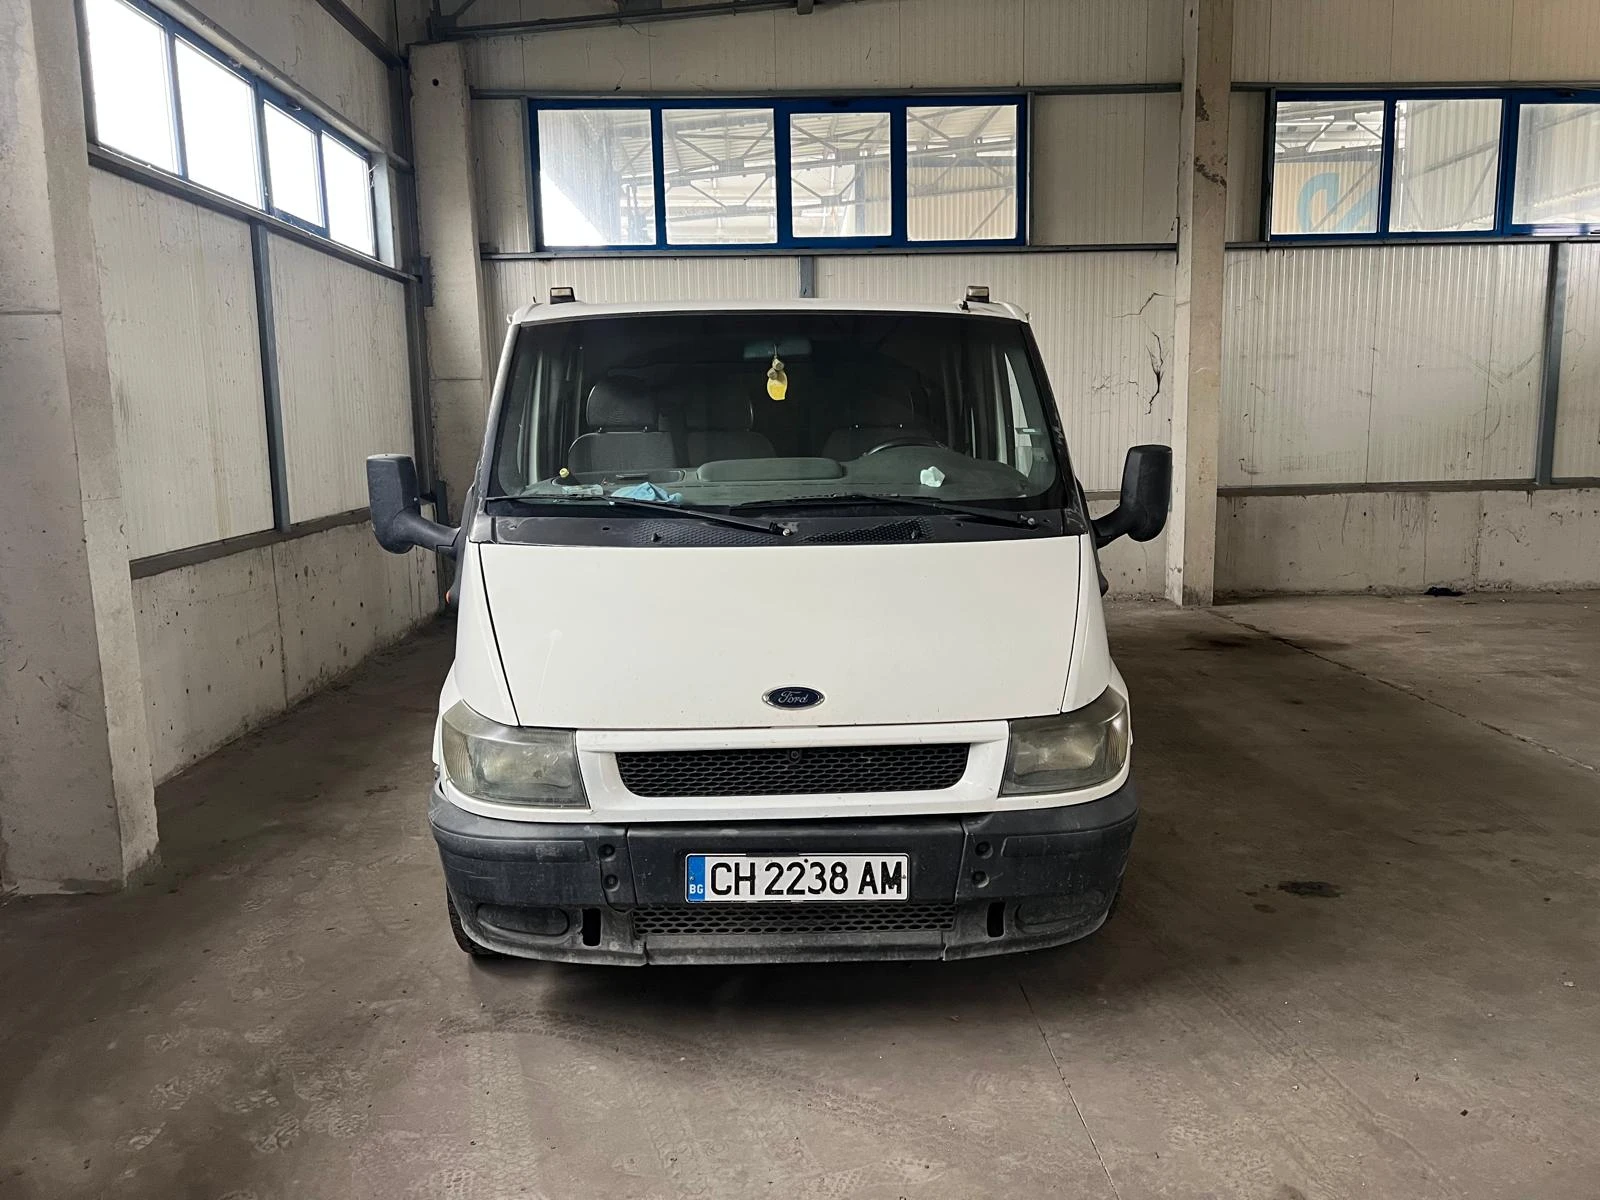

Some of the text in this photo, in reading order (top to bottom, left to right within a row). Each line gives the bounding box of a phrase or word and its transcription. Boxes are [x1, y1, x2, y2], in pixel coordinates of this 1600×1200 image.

[778, 690, 809, 704] Ford
[710, 861, 902, 896] CH 2238 AM
[689, 884, 704, 894] BG
